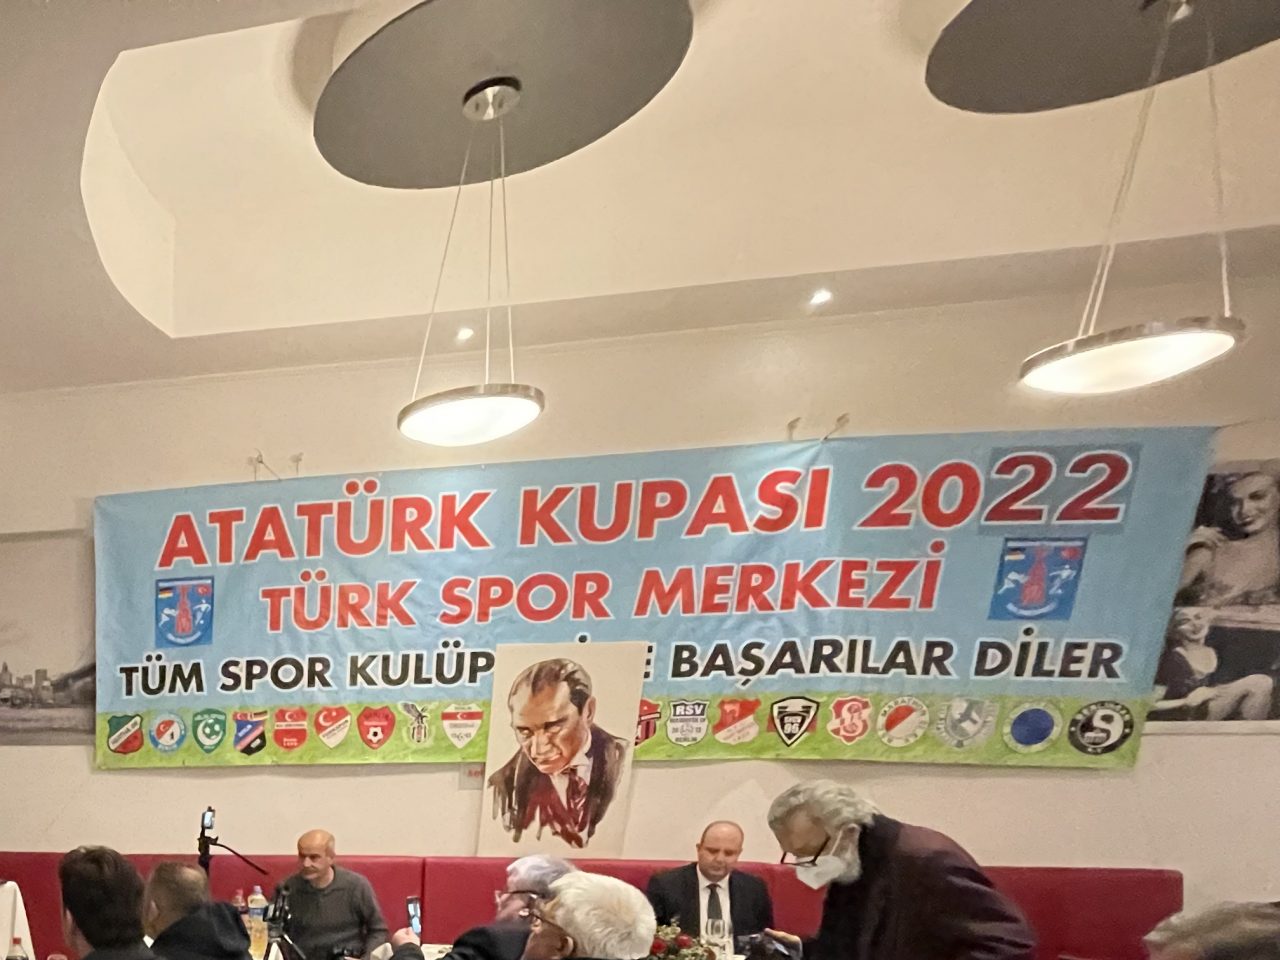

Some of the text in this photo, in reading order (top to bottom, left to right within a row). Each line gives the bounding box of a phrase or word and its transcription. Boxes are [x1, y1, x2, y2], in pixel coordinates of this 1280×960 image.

[158, 451, 1132, 569] ATATÜRK KUPASI 2022
[260, 541, 945, 632] TÜRK SPOR MERKEZİ
[118, 654, 206, 697] TÜM
[219, 656, 333, 693] SPOR
[670, 638, 956, 688] BAŞARILAR
[974, 627, 1124, 680] DİLER
[675, 703, 704, 716] RSV
